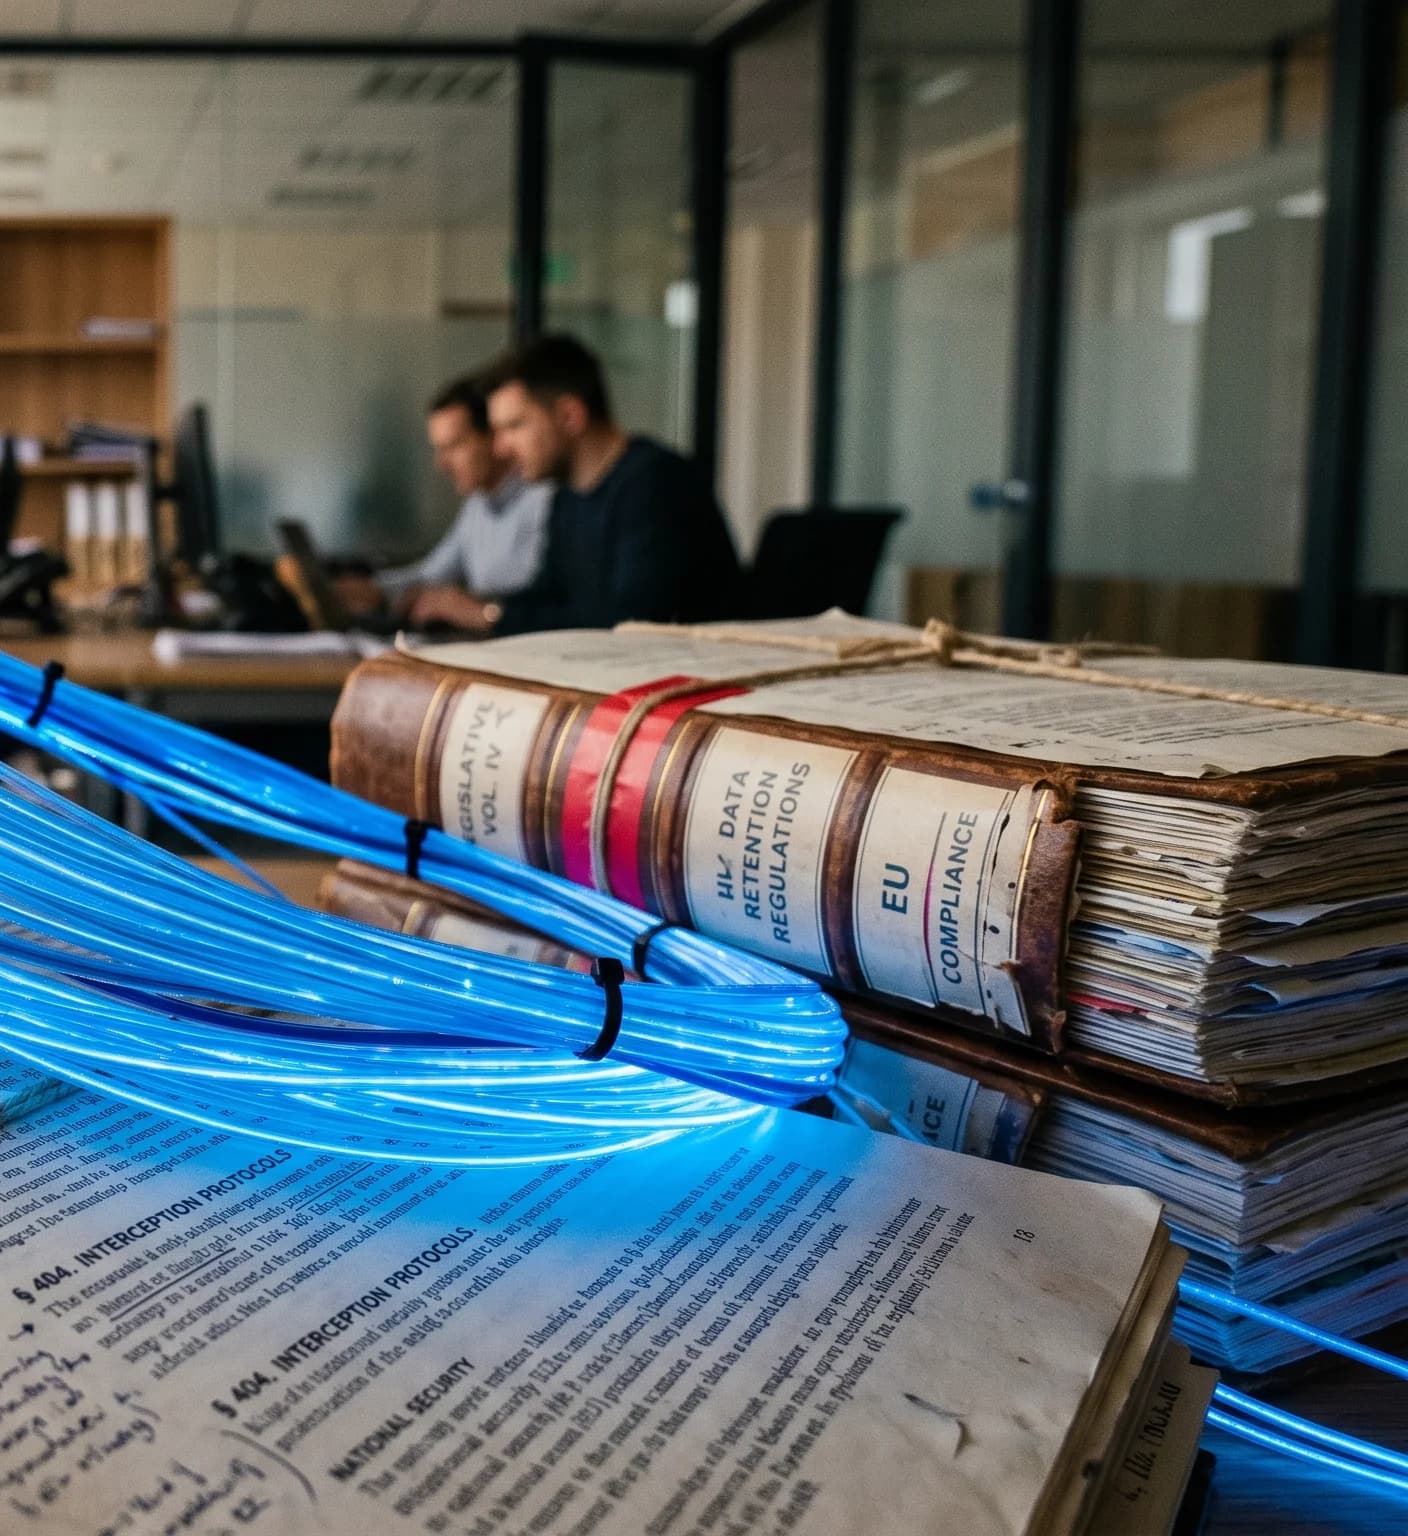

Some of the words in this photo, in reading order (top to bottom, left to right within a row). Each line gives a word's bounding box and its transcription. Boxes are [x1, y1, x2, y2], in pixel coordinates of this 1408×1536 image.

[457, 701, 495, 844] EGISLATIVE
[485, 744, 502, 770] IV
[718, 770, 751, 839] DATA
[742, 771, 779, 921] RETENTION
[768, 762, 811, 944] REGULATIONS
[882, 863, 911, 915] EU
[939, 811, 979, 985] COMPLIANCE
[11, 1287, 36, 1305] §
[32, 1265, 79, 1293] 404.
[73, 1196, 204, 1268] INTERCEPTION
[196, 1149, 293, 1202] PROTOCOLS
[1013, 1228, 1035, 1243] 18
[231, 1371, 279, 1403] 404.
[271, 1286, 393, 1373] INTERCEPTION
[384, 1226, 478, 1291] PROTOCOLS.
[328, 1413, 415, 1482] NATIONAL
[406, 1356, 476, 1416] SECURITY
